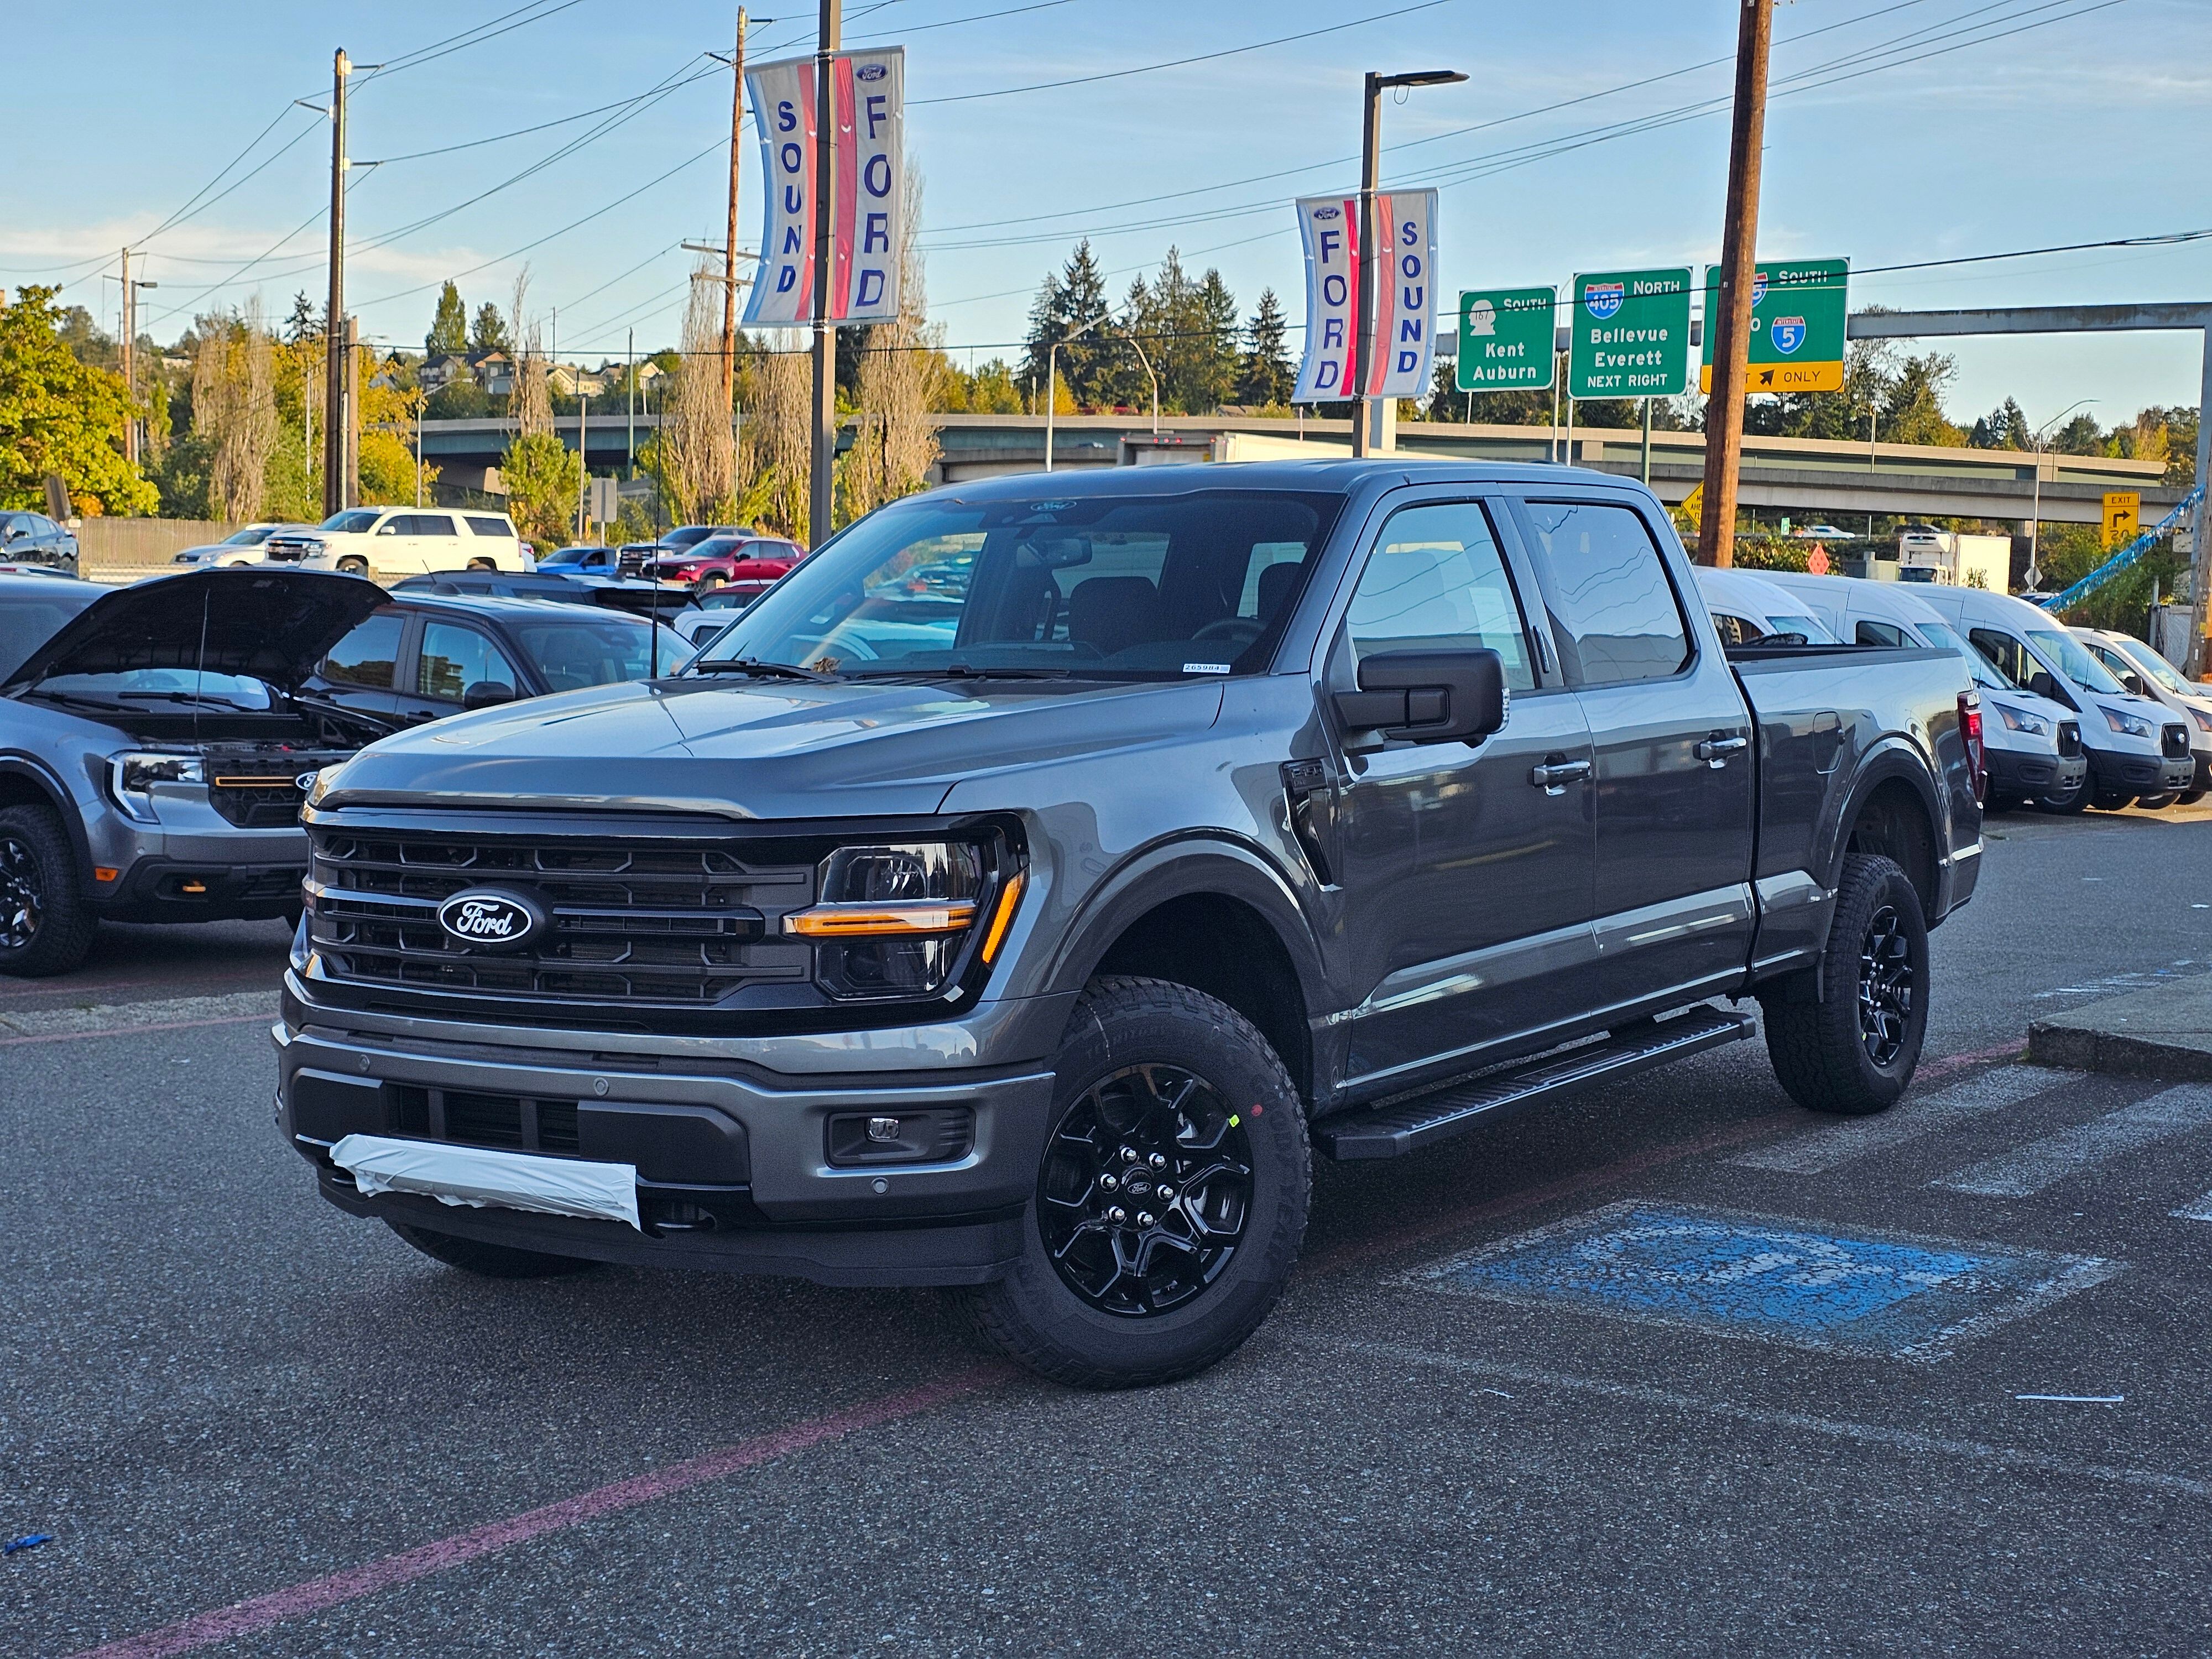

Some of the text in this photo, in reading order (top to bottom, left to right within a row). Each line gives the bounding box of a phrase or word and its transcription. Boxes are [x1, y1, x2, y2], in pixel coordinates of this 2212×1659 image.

[862, 66, 883, 80] Ford
[776, 101, 802, 293] SOUND
[855, 95, 891, 307] FORD
[1778, 270, 1827, 285] SOUTH
[1634, 280, 1680, 295] NORTH
[1397, 221, 1423, 373] SOUND
[1504, 298, 1546, 312] SOUTH
[1589, 293, 1619, 311] 405
[1314, 230, 1347, 389] FORD
[1475, 311, 1489, 321] 167
[1750, 317, 1761, 332] O
[1591, 327, 1668, 344] Bellevue
[1782, 327, 1795, 348] 5
[1485, 342, 1525, 358] Kent
[1595, 349, 1662, 367] Everett
[1473, 365, 1536, 381] Auburn
[1588, 373, 1668, 388] NEXT RIGHT
[1783, 371, 1821, 383] ONLY
[457, 902, 513, 935] Ford
[1131, 1183, 1147, 1193] Ford
